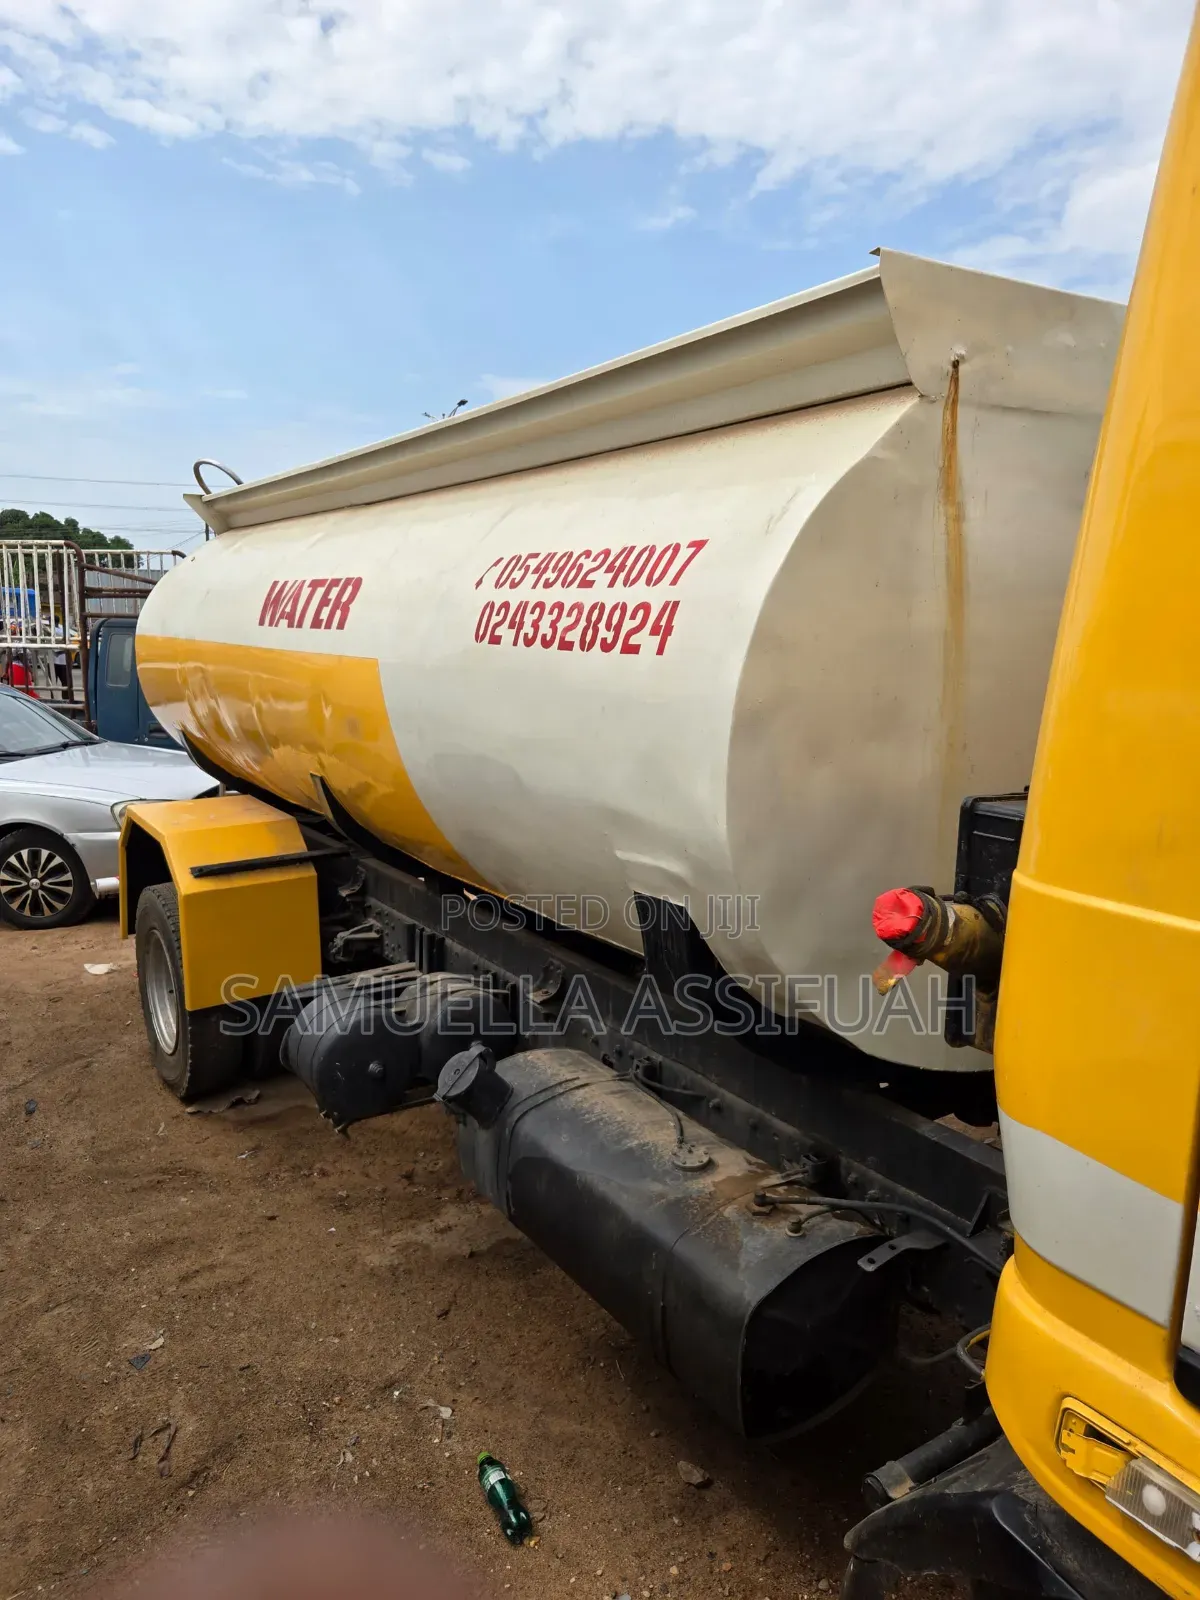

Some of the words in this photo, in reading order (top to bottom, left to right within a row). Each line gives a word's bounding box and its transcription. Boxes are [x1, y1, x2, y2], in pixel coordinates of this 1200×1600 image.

[494, 539, 709, 590] 0549624007
[259, 576, 362, 630] WATER
[474, 600, 680, 656] 0243328924
